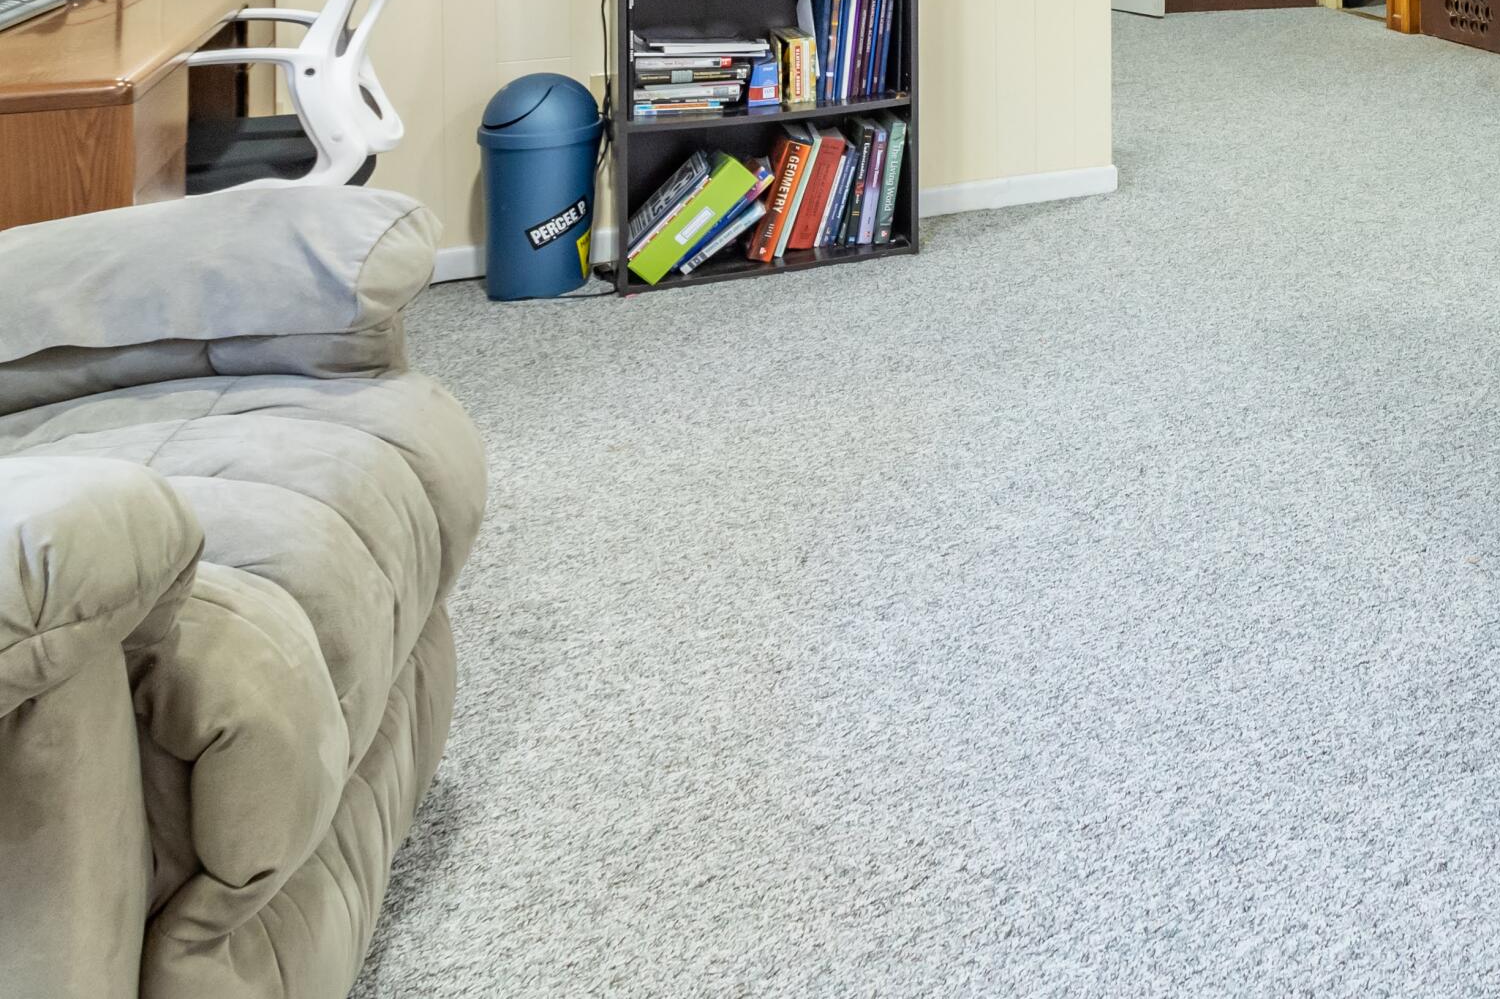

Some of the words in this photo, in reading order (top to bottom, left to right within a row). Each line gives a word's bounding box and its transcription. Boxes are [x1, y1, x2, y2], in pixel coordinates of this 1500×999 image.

[892, 144, 901, 158] The
[772, 155, 801, 214] GEOMETRY
[885, 160, 899, 186] Living
[884, 186, 896, 212] World
[530, 207, 578, 245] PERCEE
